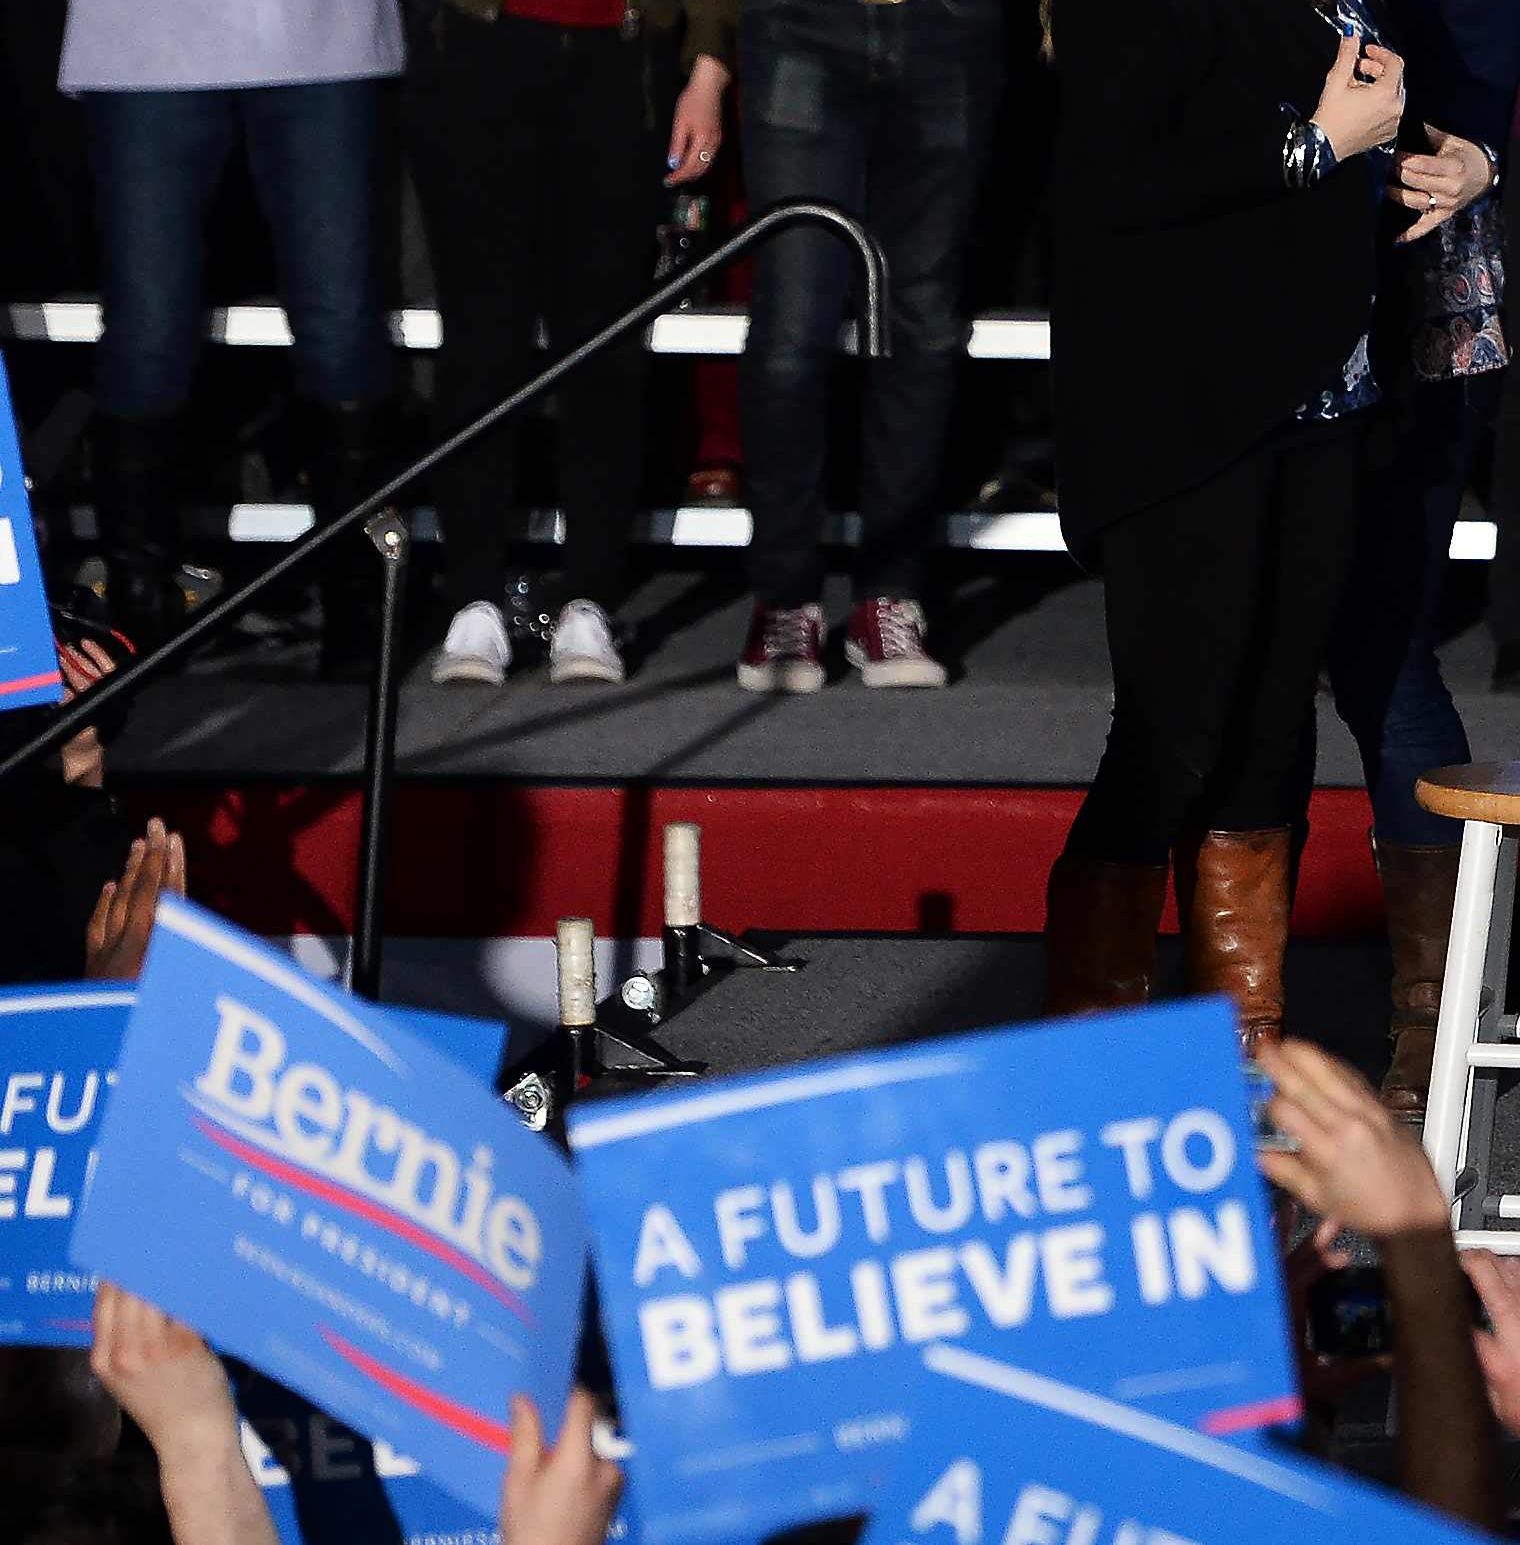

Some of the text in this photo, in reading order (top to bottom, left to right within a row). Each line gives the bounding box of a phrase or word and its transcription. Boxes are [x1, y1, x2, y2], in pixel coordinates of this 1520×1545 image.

[192, 992, 546, 1292] Bernie
[633, 1107, 1238, 1288] A FUTURE TO
[636, 1200, 1258, 1391] BELIEVE IN
[911, 1457, 983, 1538] A
